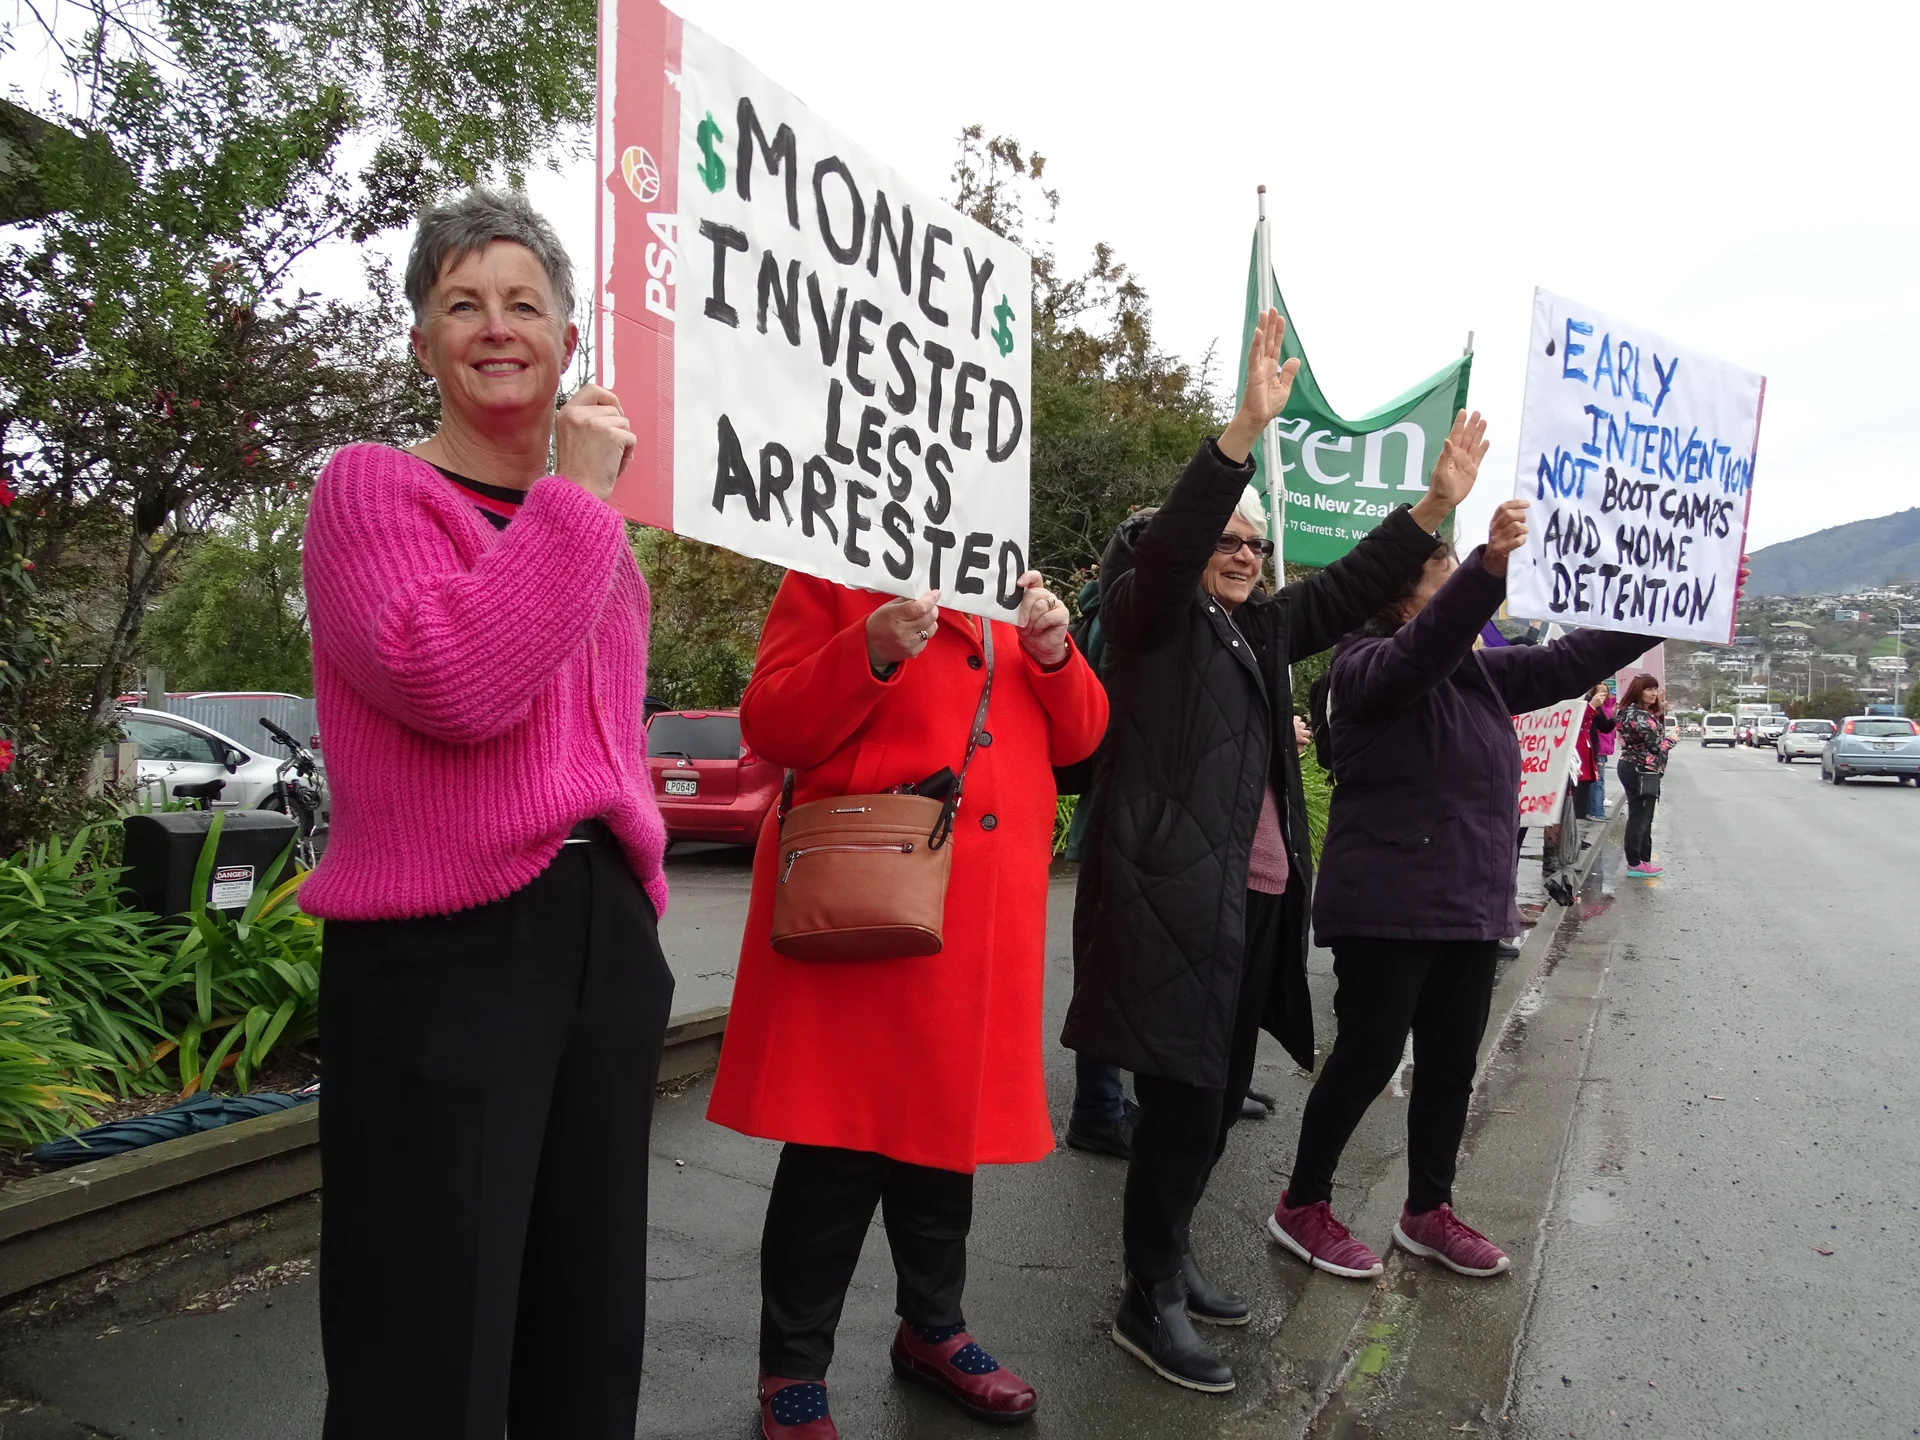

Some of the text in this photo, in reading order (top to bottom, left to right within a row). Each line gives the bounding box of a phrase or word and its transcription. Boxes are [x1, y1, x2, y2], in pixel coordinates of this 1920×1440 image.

[645, 212, 677, 322] PSA
[699, 217, 1024, 463] INVESTED
[1562, 317, 1679, 418] EARLY
[823, 378, 955, 525] LESS
[1276, 416, 1430, 492] een
[1536, 444, 1735, 539] NOT BOOT CAMPS
[1581, 403, 1756, 497] INTERVENTION
[712, 413, 1025, 610] ARRESTED
[1289, 519, 1299, 531] 17
[1299, 521, 1333, 537] Garrett
[1335, 528, 1349, 540] St,
[1313, 493, 1351, 514] New
[1352, 498, 1399, 518] Zeal
[1543, 508, 1694, 572] AND HOME
[1549, 563, 1716, 625] DETENTION
[217, 871, 248, 879] DANGER
